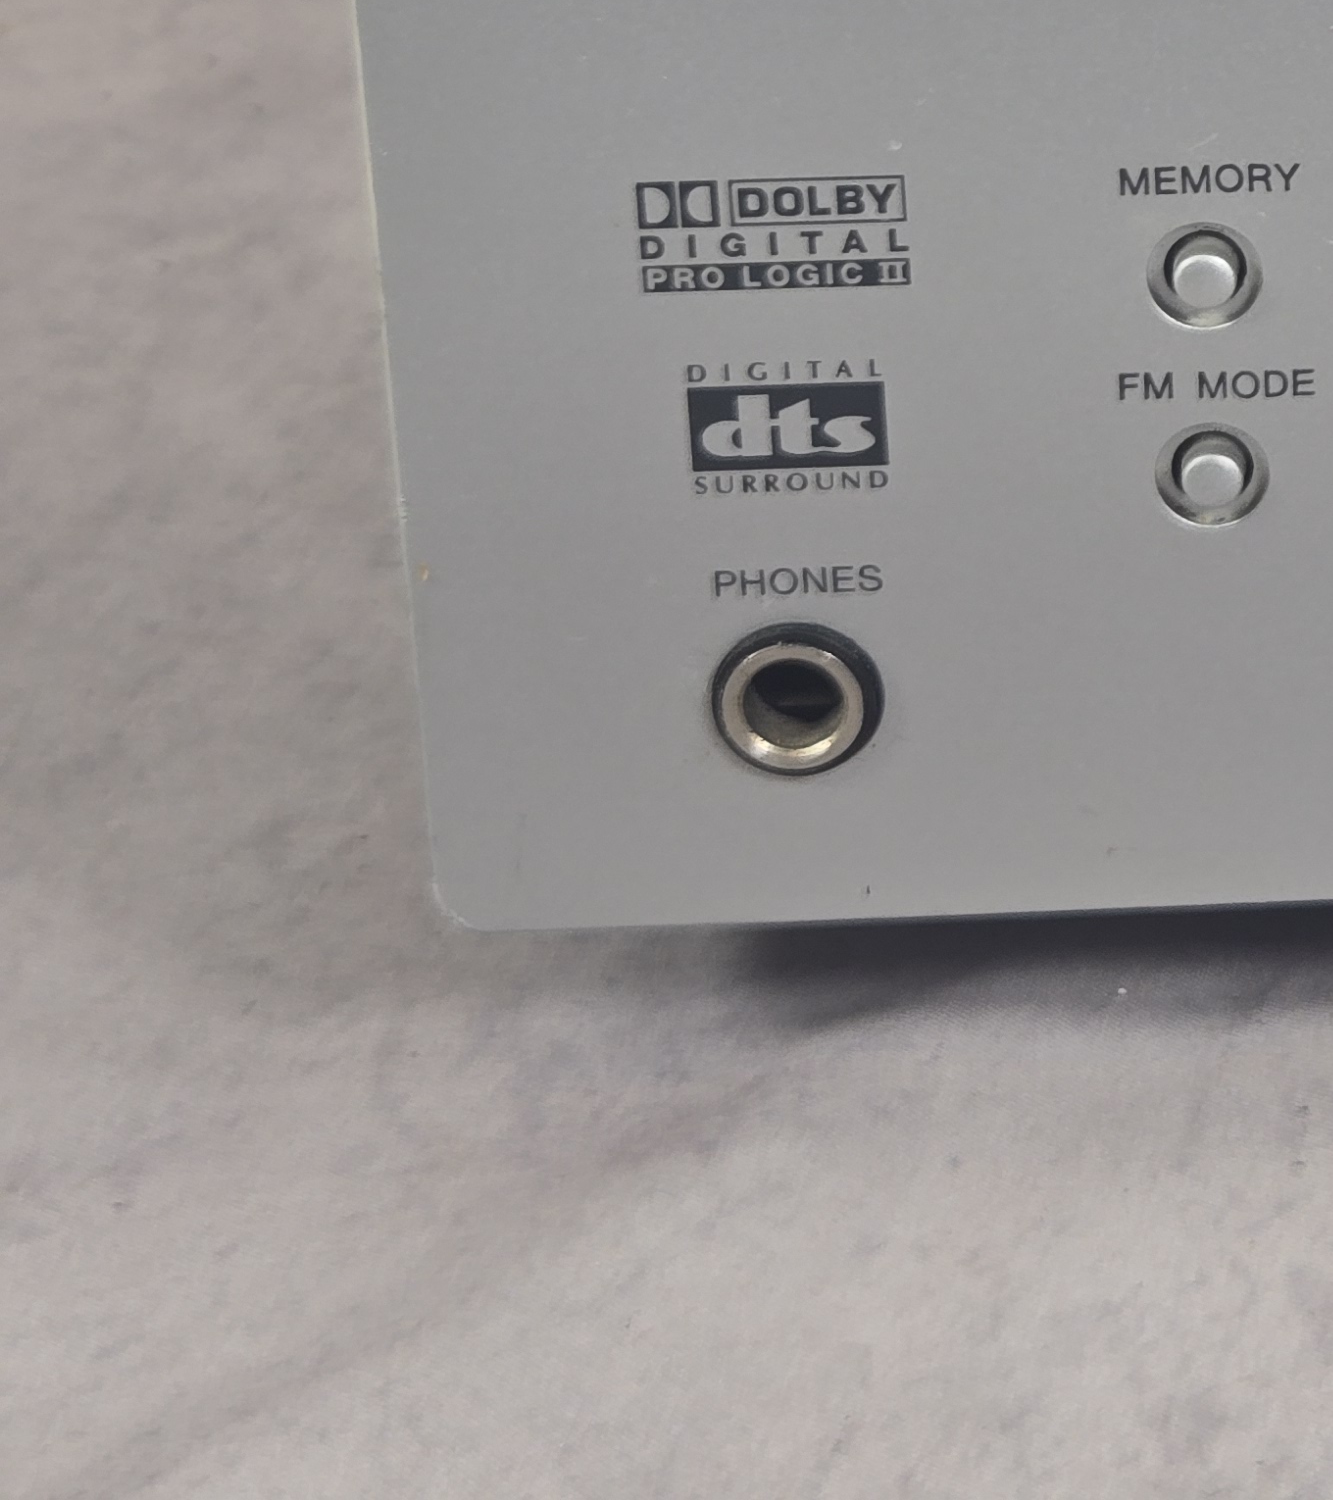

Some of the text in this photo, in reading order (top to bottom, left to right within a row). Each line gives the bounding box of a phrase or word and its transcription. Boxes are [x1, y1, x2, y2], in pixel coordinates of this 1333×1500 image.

[1117, 161, 1302, 198] MEMORY
[736, 183, 898, 218] DOLBY
[638, 228, 911, 260] DIGITAL
[646, 264, 725, 292] PRO
[741, 258, 865, 290] LOGIC
[686, 358, 883, 383] DIGITAL
[1117, 367, 1317, 402] FM MODE
[701, 392, 877, 457] dts
[693, 469, 890, 495] SURROUND
[712, 563, 884, 599] PHONES
